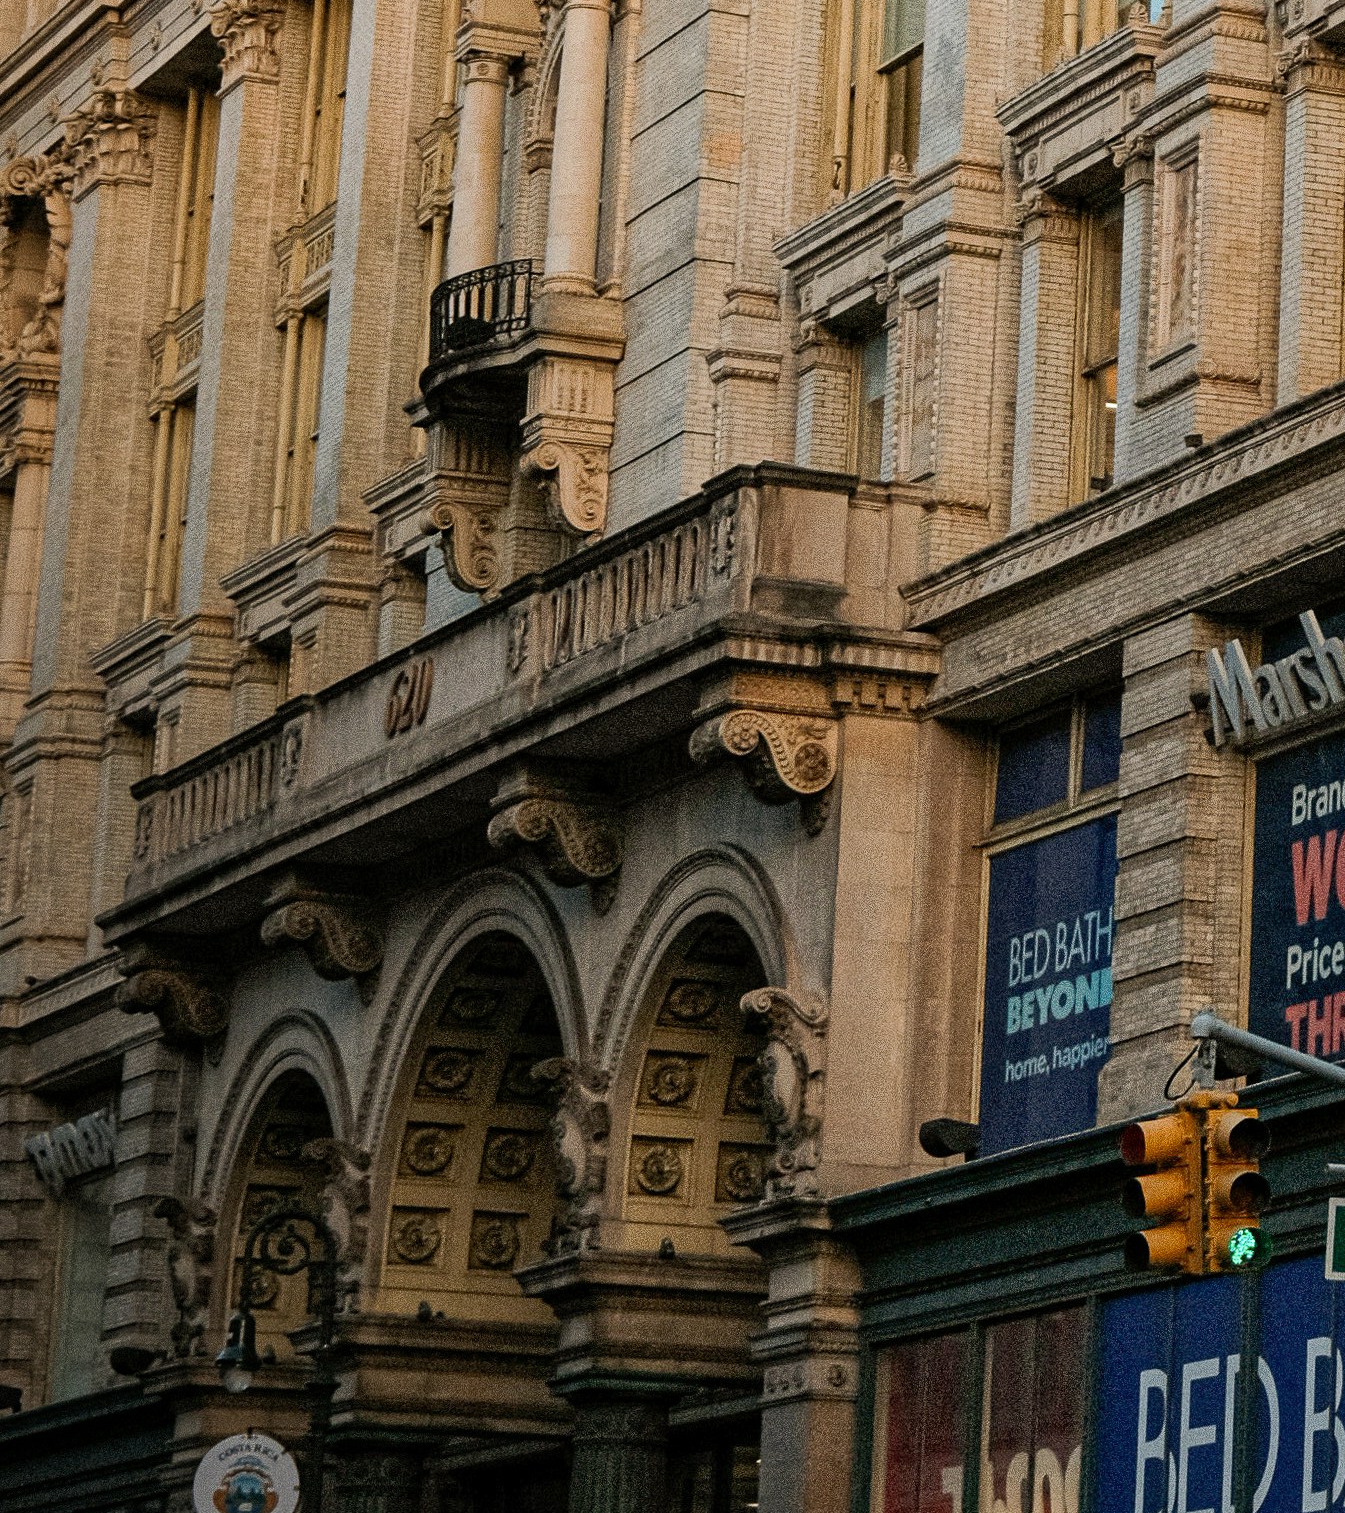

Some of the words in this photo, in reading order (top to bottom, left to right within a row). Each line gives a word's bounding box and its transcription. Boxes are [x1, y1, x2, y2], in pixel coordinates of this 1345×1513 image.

[1008, 936, 1051, 988] BED
[1054, 906, 1113, 973] BATH
[1004, 1053, 1051, 1084] home,
[1051, 1033, 1112, 1071] happier
